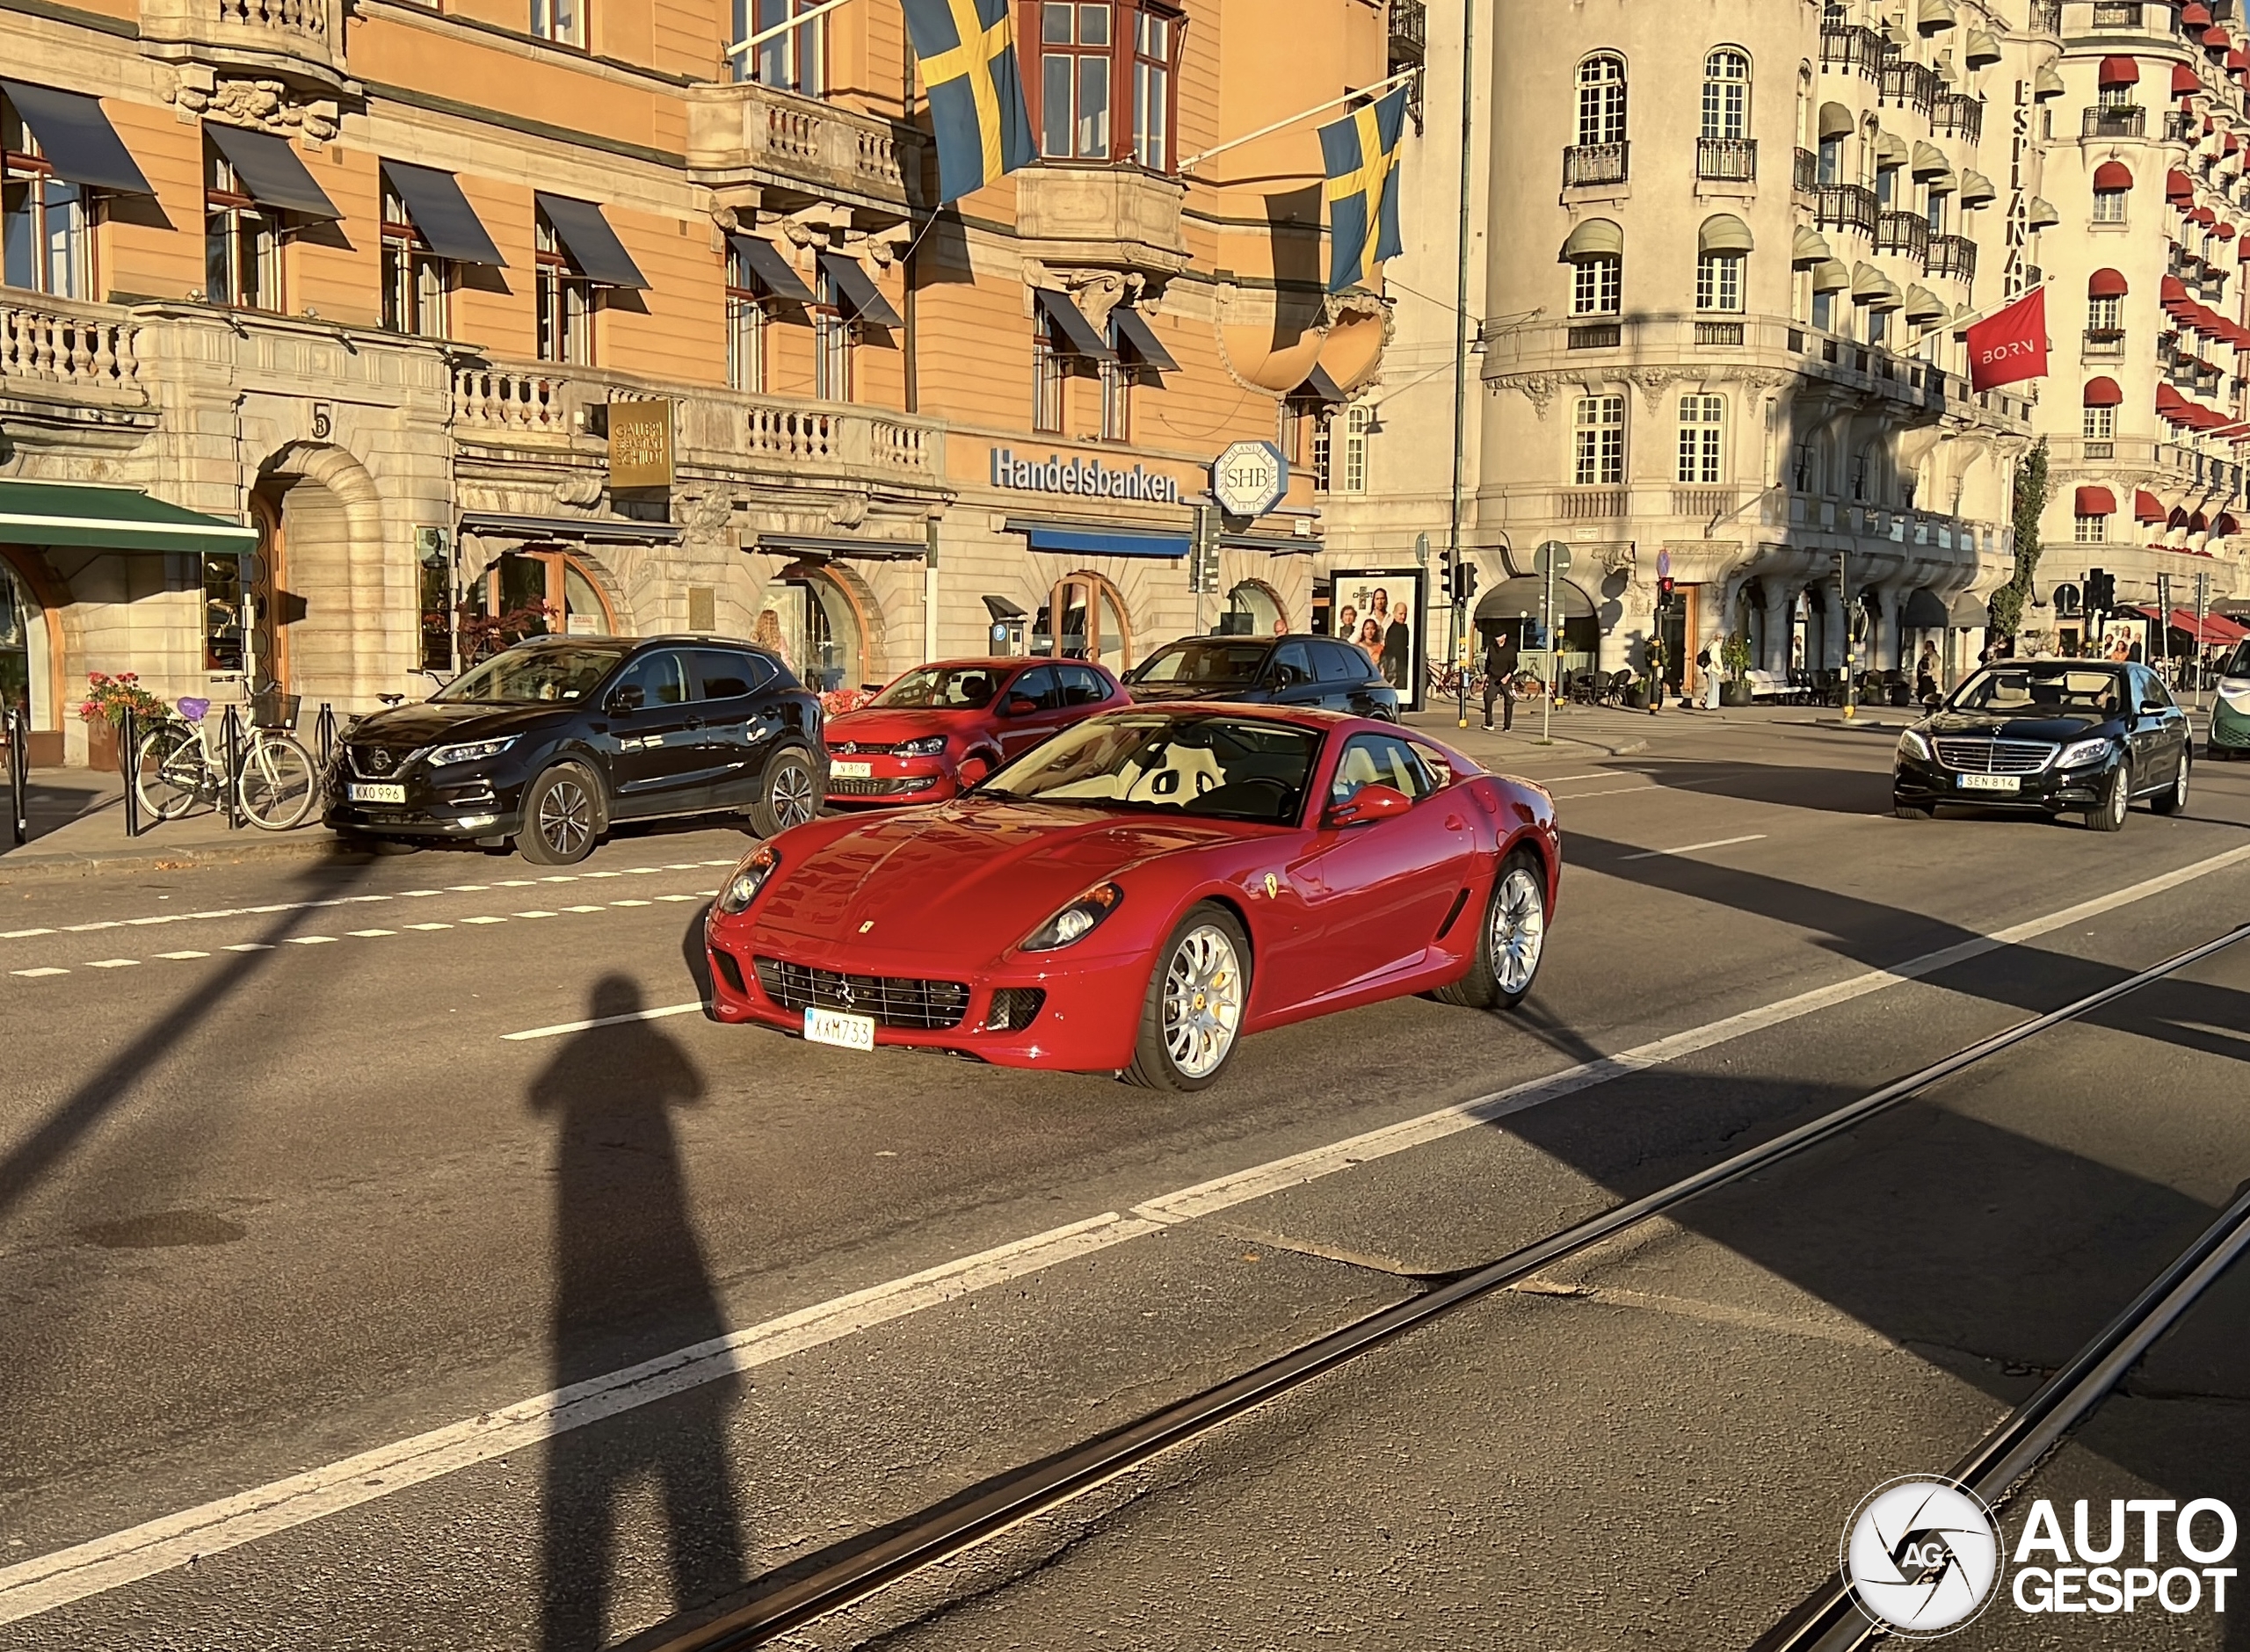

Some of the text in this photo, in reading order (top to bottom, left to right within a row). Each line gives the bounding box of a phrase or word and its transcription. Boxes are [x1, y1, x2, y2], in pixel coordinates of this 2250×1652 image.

[2004, 79, 2030, 306] ESPLANAD
[1983, 339, 2034, 364] BORN
[614, 421, 663, 438] GALLERI
[616, 449, 664, 466] SCHILDT
[991, 447, 1179, 502] Handelsbanken
[1227, 467, 1267, 488] SHB
[1238, 502, 1255, 511] 1871
[1967, 776, 2014, 787] SEN 814
[378, 787, 399, 800] 996
